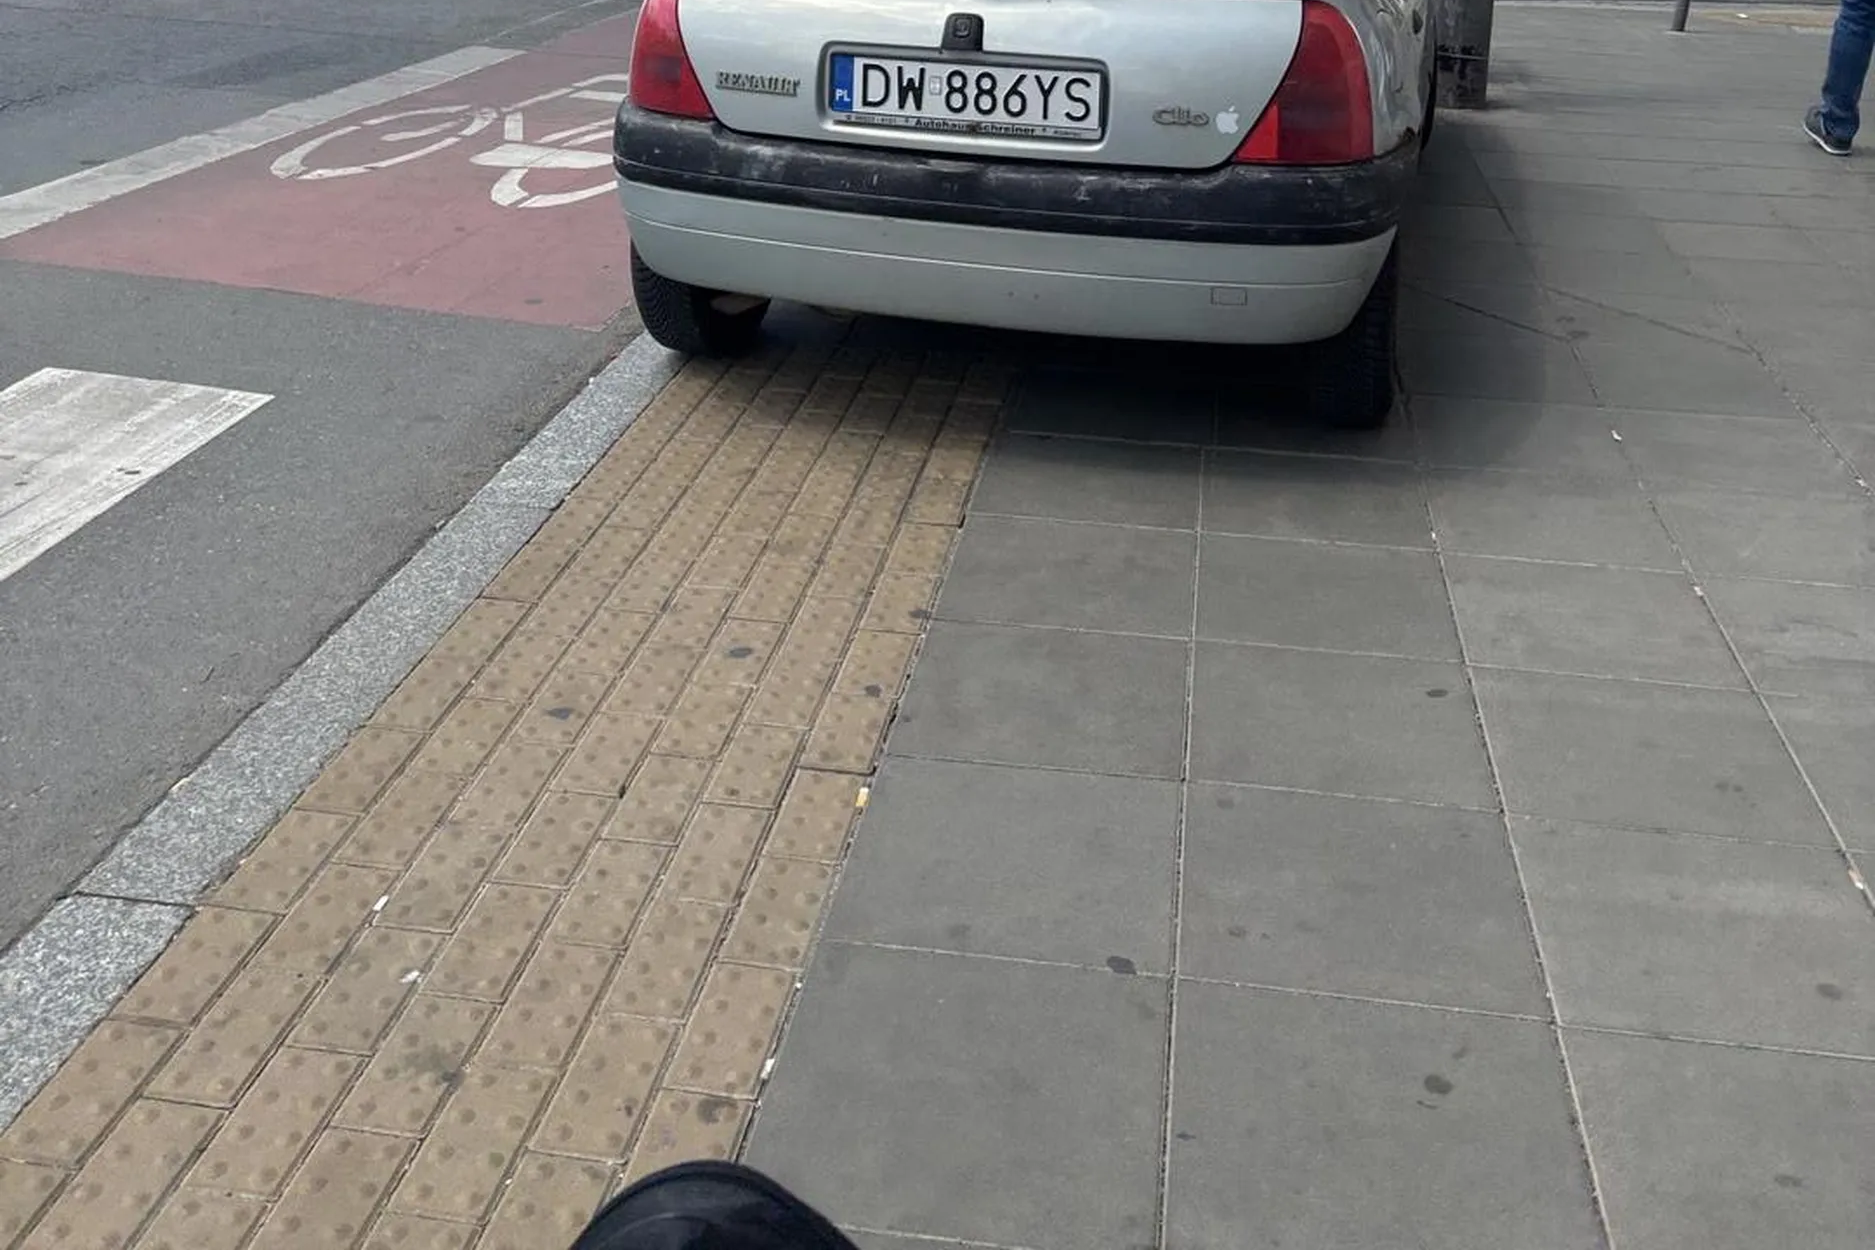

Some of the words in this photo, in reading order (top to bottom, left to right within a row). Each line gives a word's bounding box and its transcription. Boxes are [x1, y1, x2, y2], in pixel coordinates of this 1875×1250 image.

[716, 70, 800, 97] RENAULT
[835, 89, 851, 102] PL
[862, 63, 926, 111] DW
[944, 69, 1093, 123] 886YS
[1152, 106, 1210, 127] Clio
